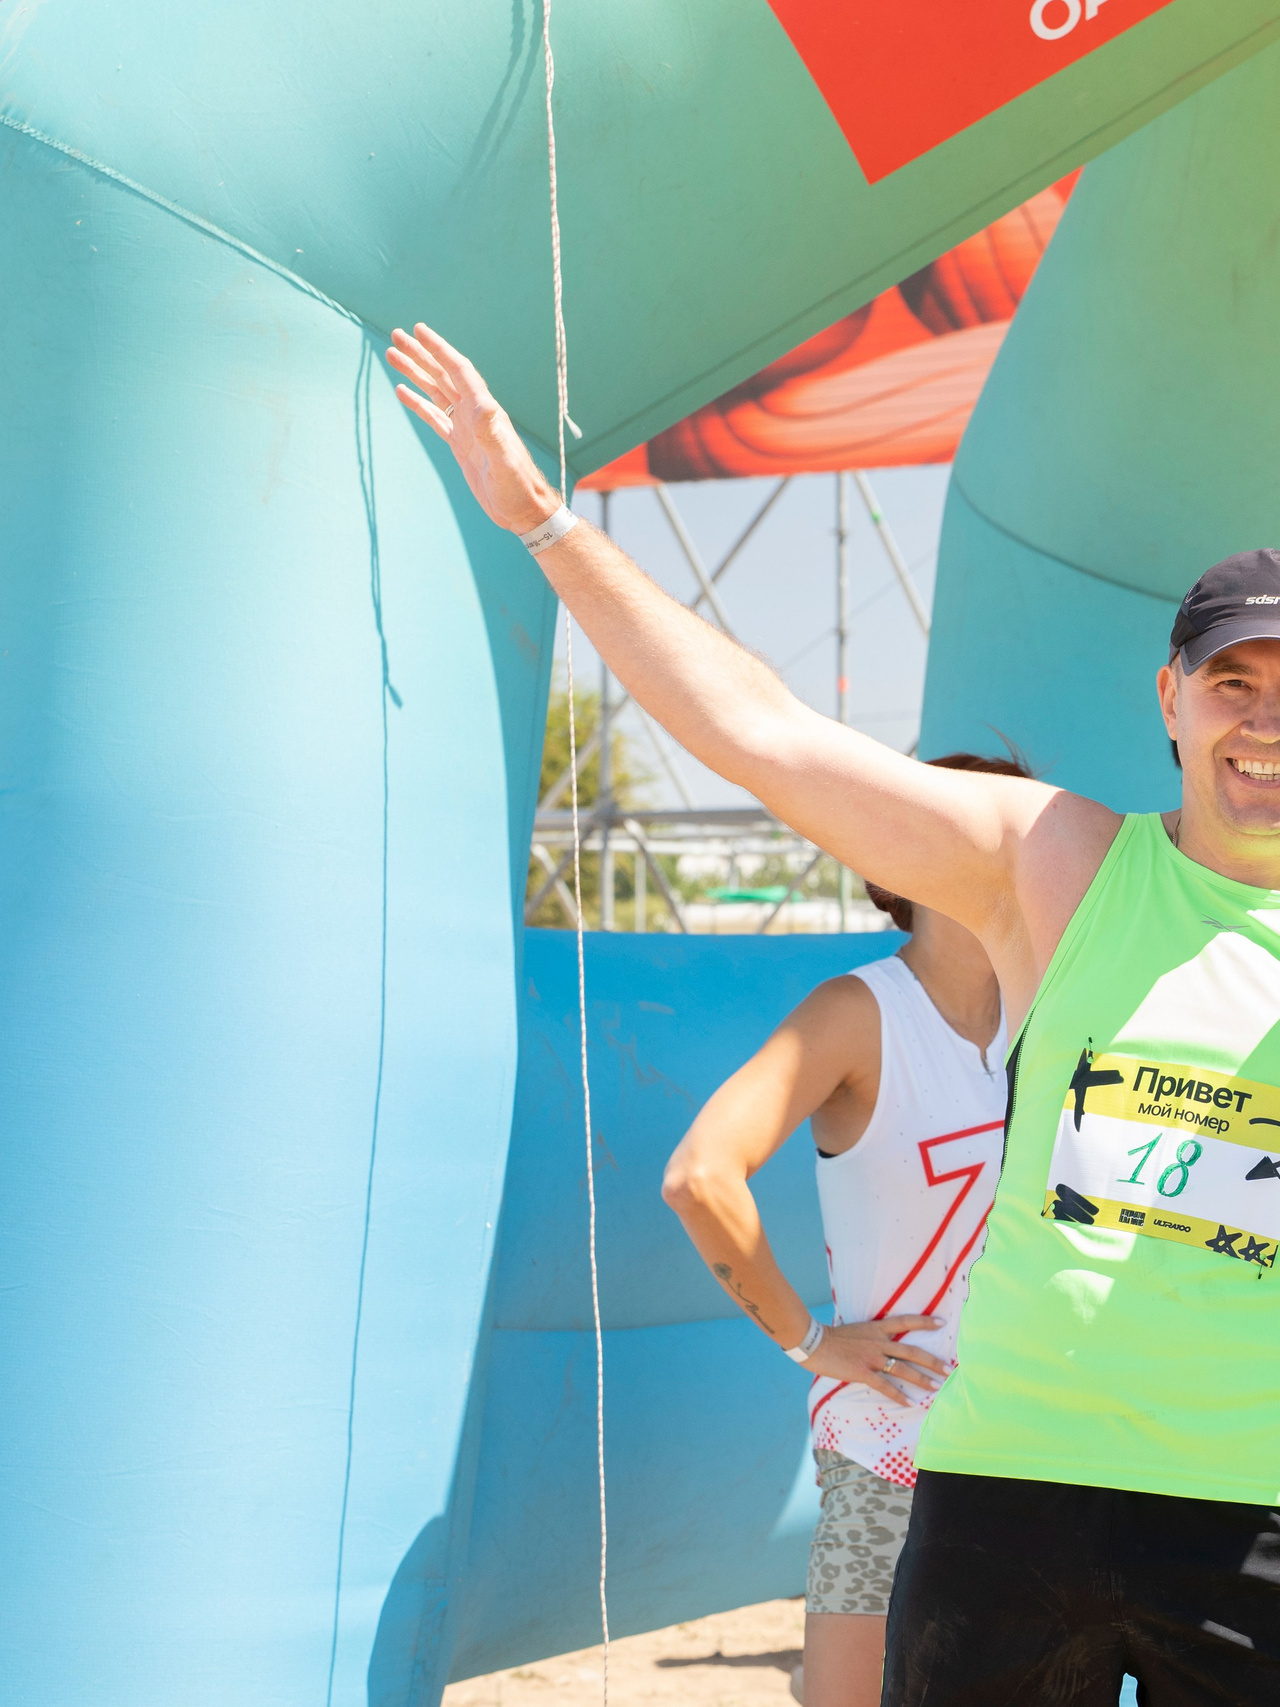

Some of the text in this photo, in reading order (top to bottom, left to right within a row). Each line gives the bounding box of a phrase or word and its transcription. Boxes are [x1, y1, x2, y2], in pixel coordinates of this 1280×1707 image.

[1132, 1066, 1253, 1113] Привет
[1137, 1102, 1230, 1134] мой номер
[1115, 1132, 1203, 1198] 18
[1153, 1218, 1192, 1233] ULTRA100
